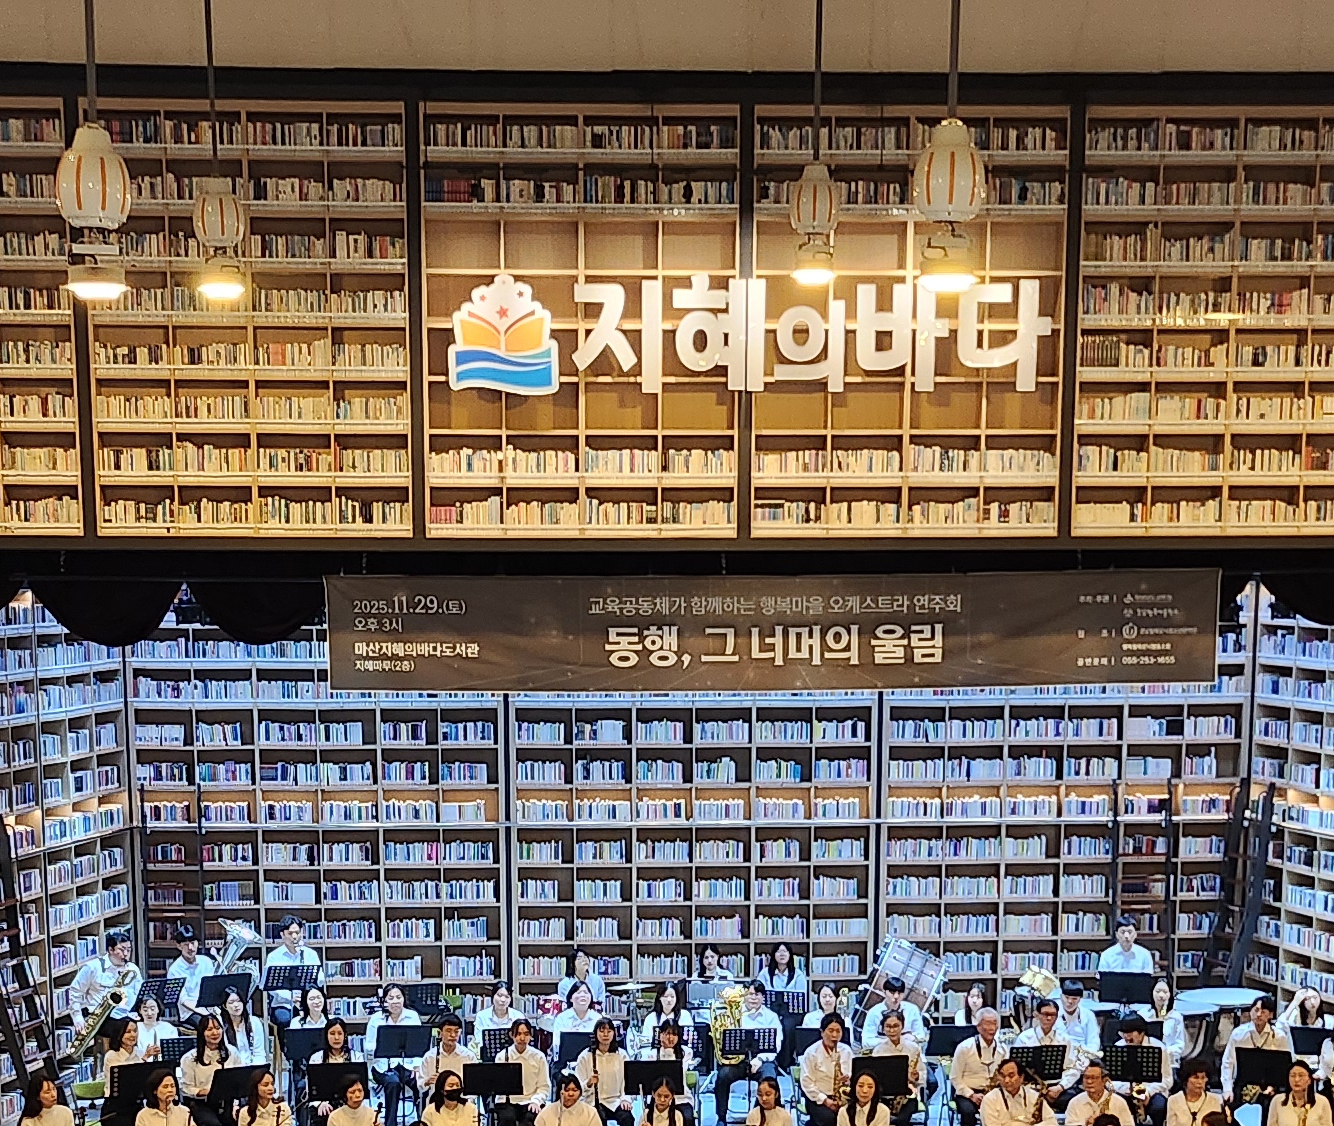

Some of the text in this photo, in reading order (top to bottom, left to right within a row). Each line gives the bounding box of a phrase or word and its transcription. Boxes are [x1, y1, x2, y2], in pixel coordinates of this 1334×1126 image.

[353, 595, 466, 615] 2025.11.29.(토)
[588, 594, 962, 616] 교육공동체가 함께하는 행복마을 오케스트라 연주회
[354, 617, 403, 633] 오후 3시
[354, 641, 480, 658] 마산지혜의바다도서관
[604, 623, 945, 670] 동행, 그 너머의 울림
